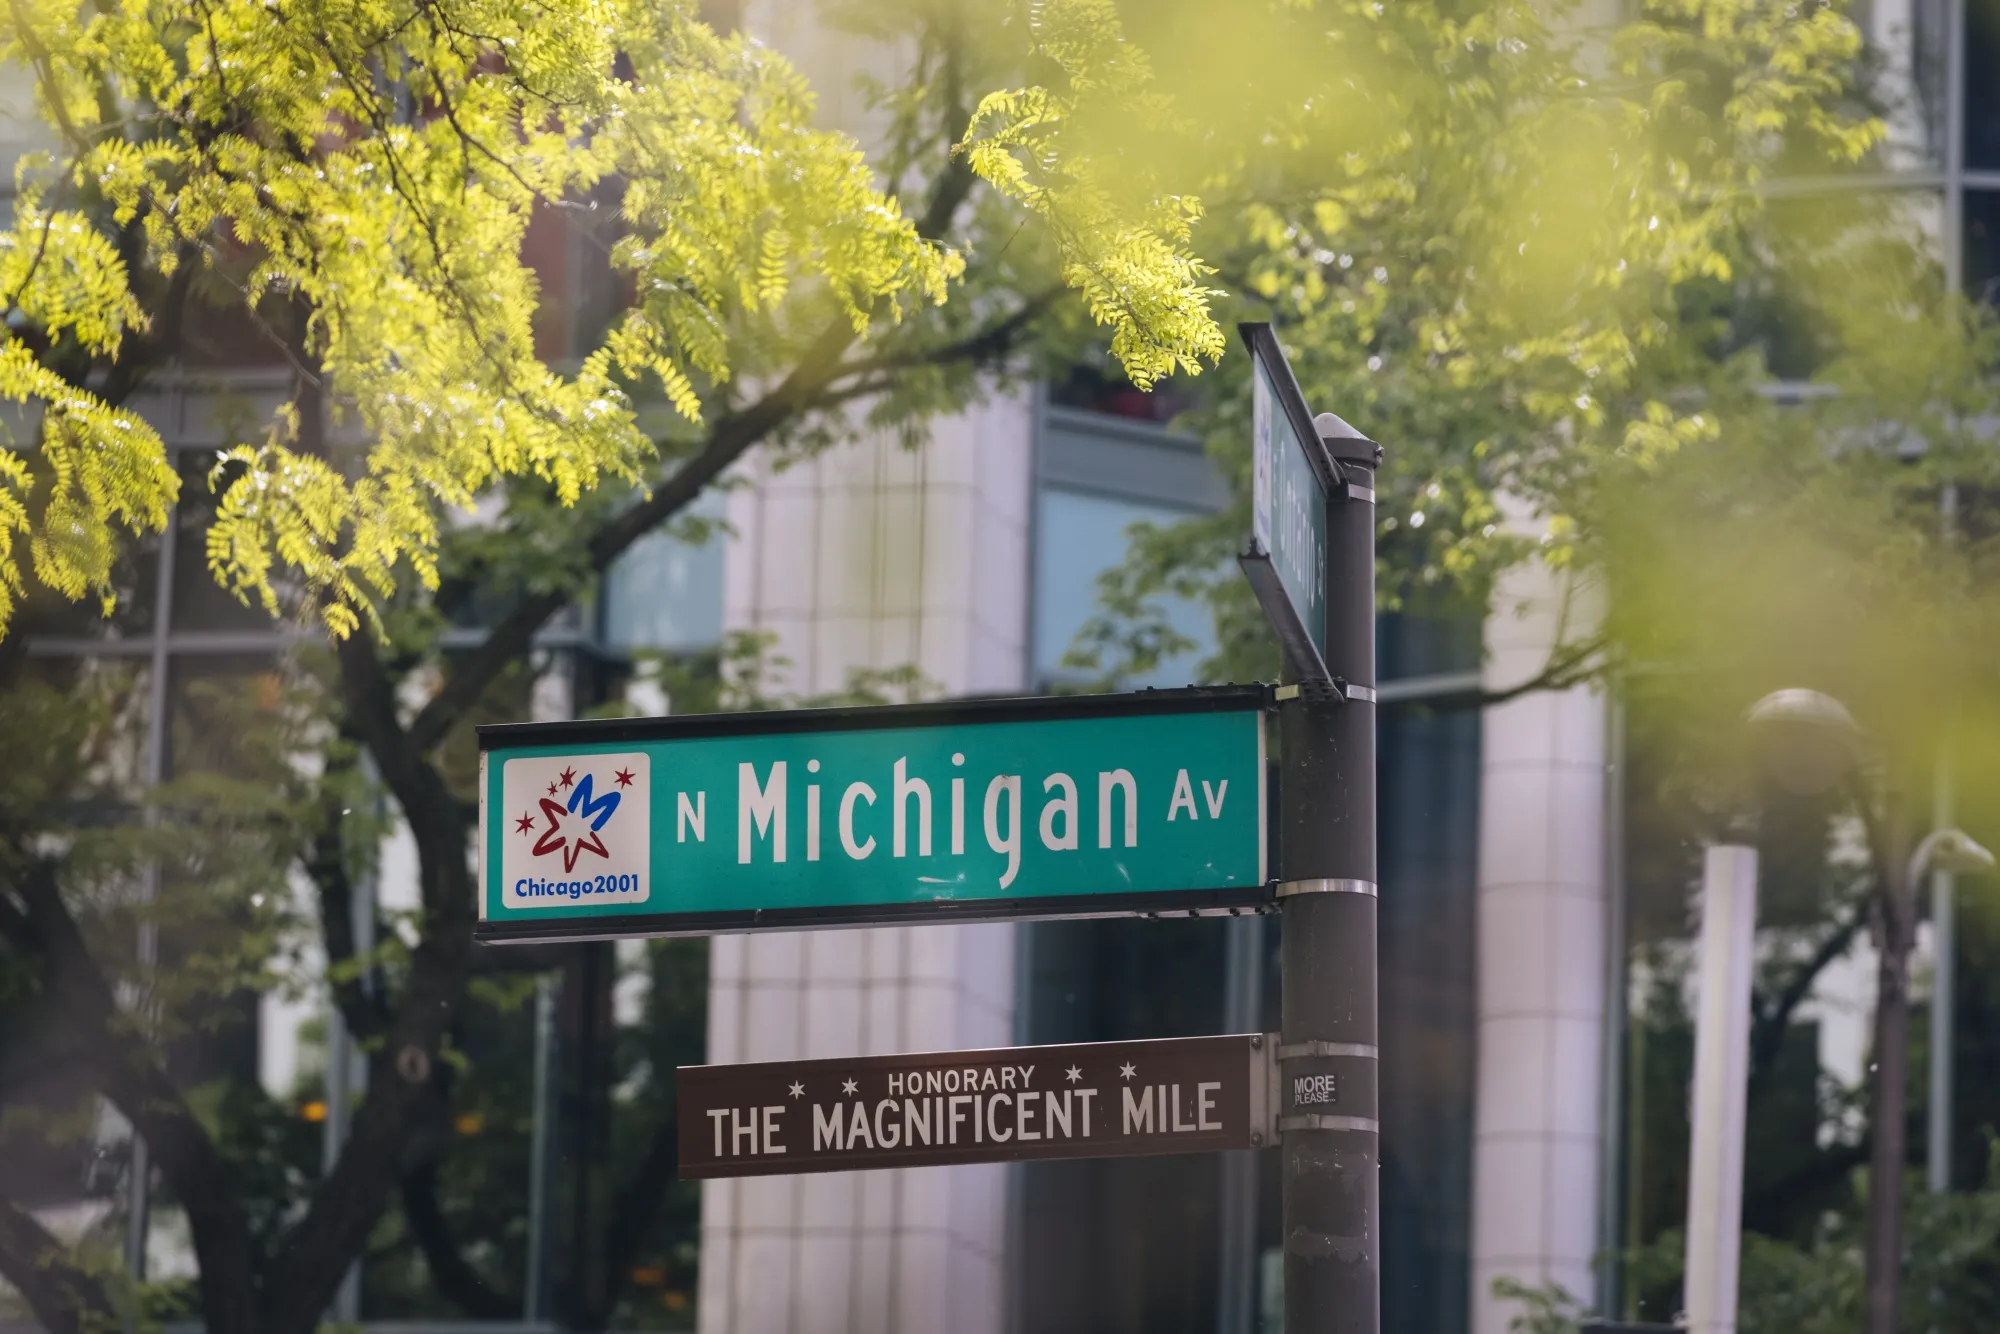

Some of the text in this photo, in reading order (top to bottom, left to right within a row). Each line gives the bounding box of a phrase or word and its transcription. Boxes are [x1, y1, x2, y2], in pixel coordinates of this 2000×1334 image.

[677, 752, 1229, 890] N Michigan Av
[515, 873, 639, 900] Chicago2001
[888, 1064, 1036, 1096] HONORARY
[1294, 1074, 1336, 1095] MORE
[706, 1081, 1223, 1157] THE MAGNIFICENT MILE
